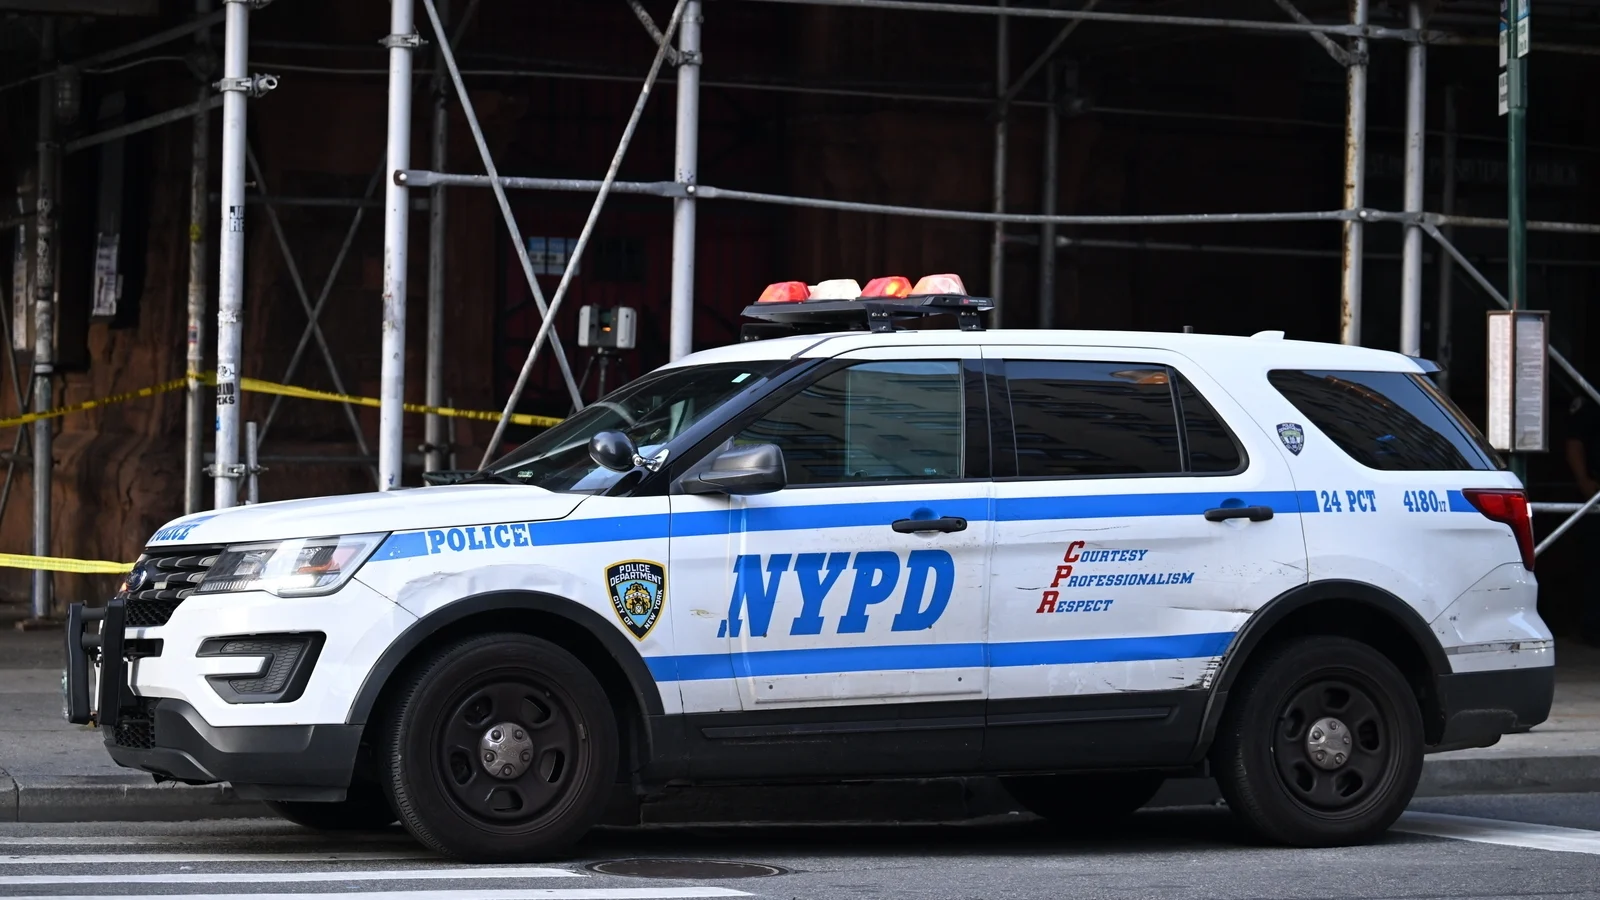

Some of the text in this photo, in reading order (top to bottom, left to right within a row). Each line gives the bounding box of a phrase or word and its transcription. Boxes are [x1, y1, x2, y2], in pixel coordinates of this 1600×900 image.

[1321, 490, 1342, 512] 24
[1345, 490, 1377, 512] PCT
[427, 524, 529, 554] POLICE
[1063, 540, 1148, 563] COURTESY
[610, 571, 662, 587] DEPARTMENT
[619, 563, 650, 573] POLICE
[1050, 565, 1195, 588] PROFESSIONALISM
[717, 549, 955, 638] NYPD
[1036, 591, 1114, 613] RESPECT
[613, 595, 633, 626] CITY OF
[644, 589, 663, 630] NEW YORK
